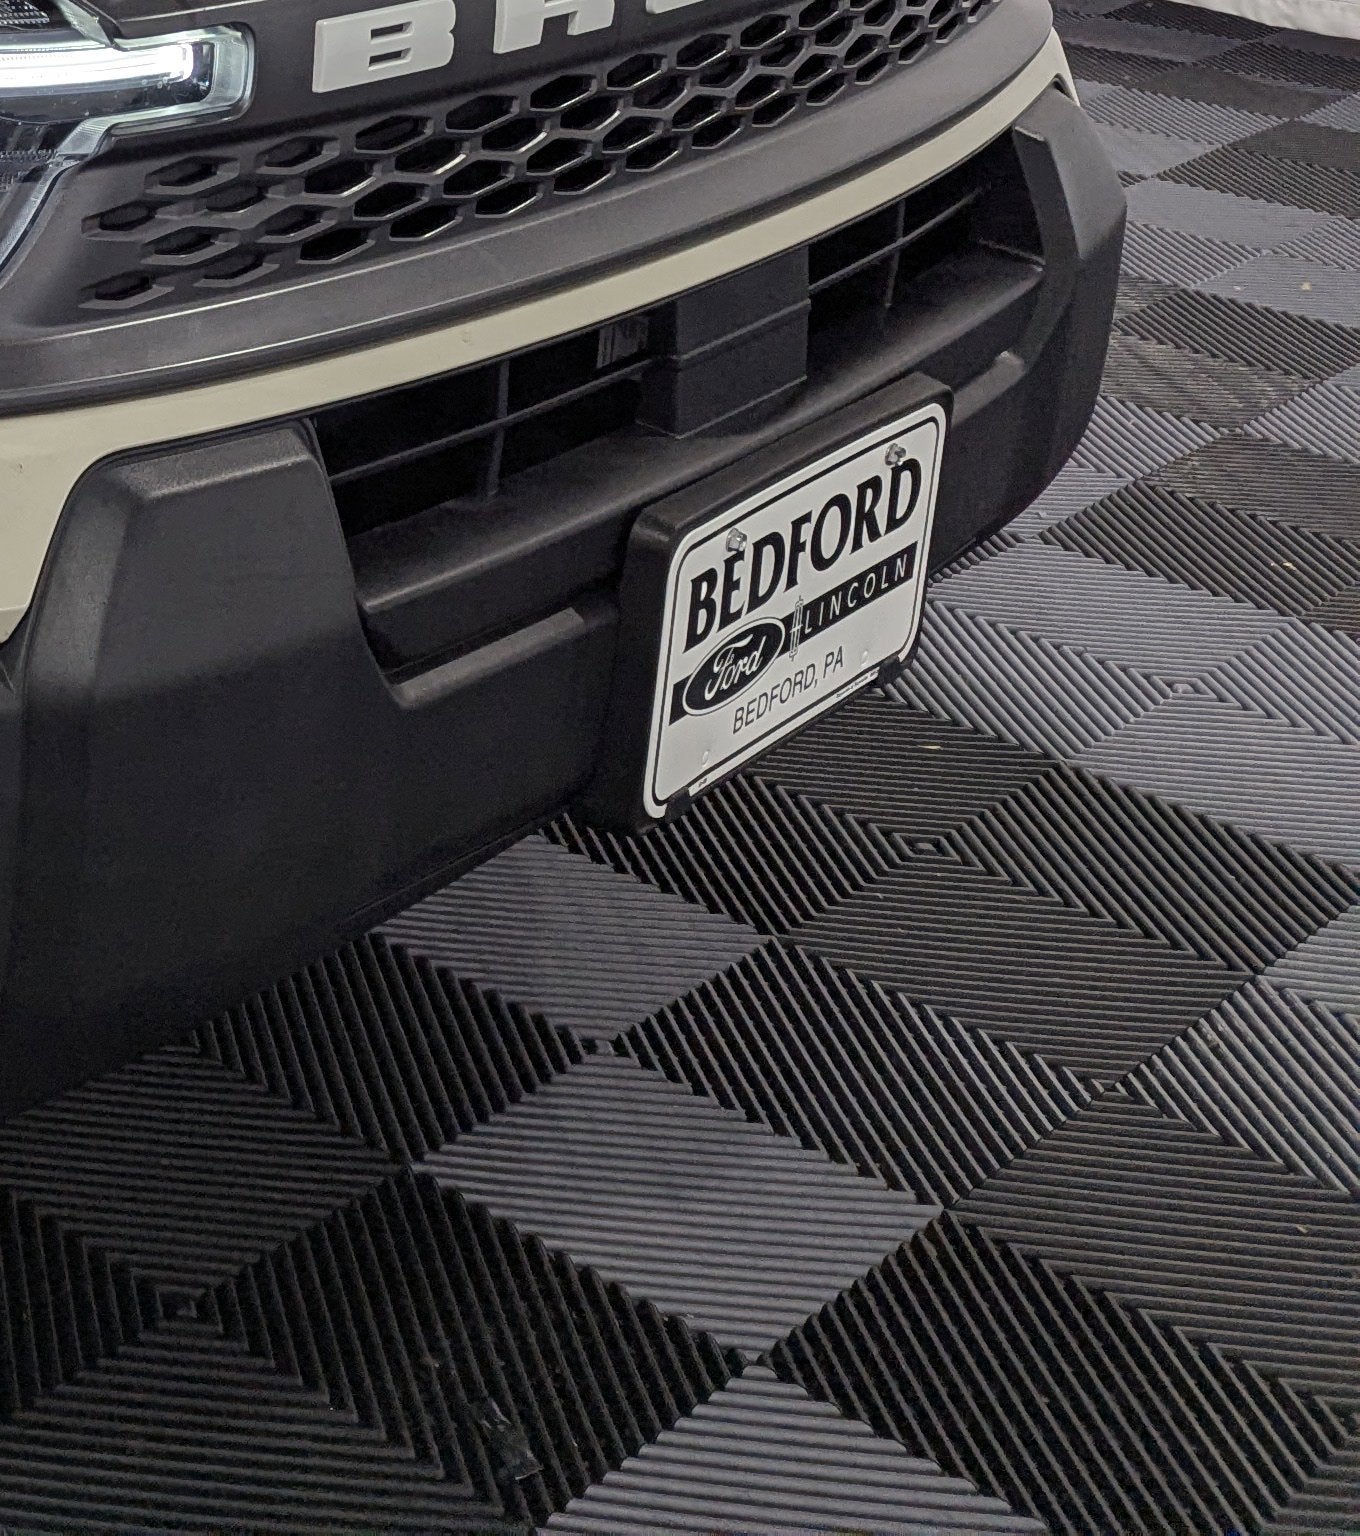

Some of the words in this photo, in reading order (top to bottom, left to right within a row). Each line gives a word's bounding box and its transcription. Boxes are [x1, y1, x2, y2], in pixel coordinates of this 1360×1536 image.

[682, 458, 922, 654] BEDFORD
[704, 634, 767, 701] Ford
[804, 554, 908, 634] LINCOLN
[733, 663, 818, 735] BEDFORD,
[823, 646, 844, 679] PA
